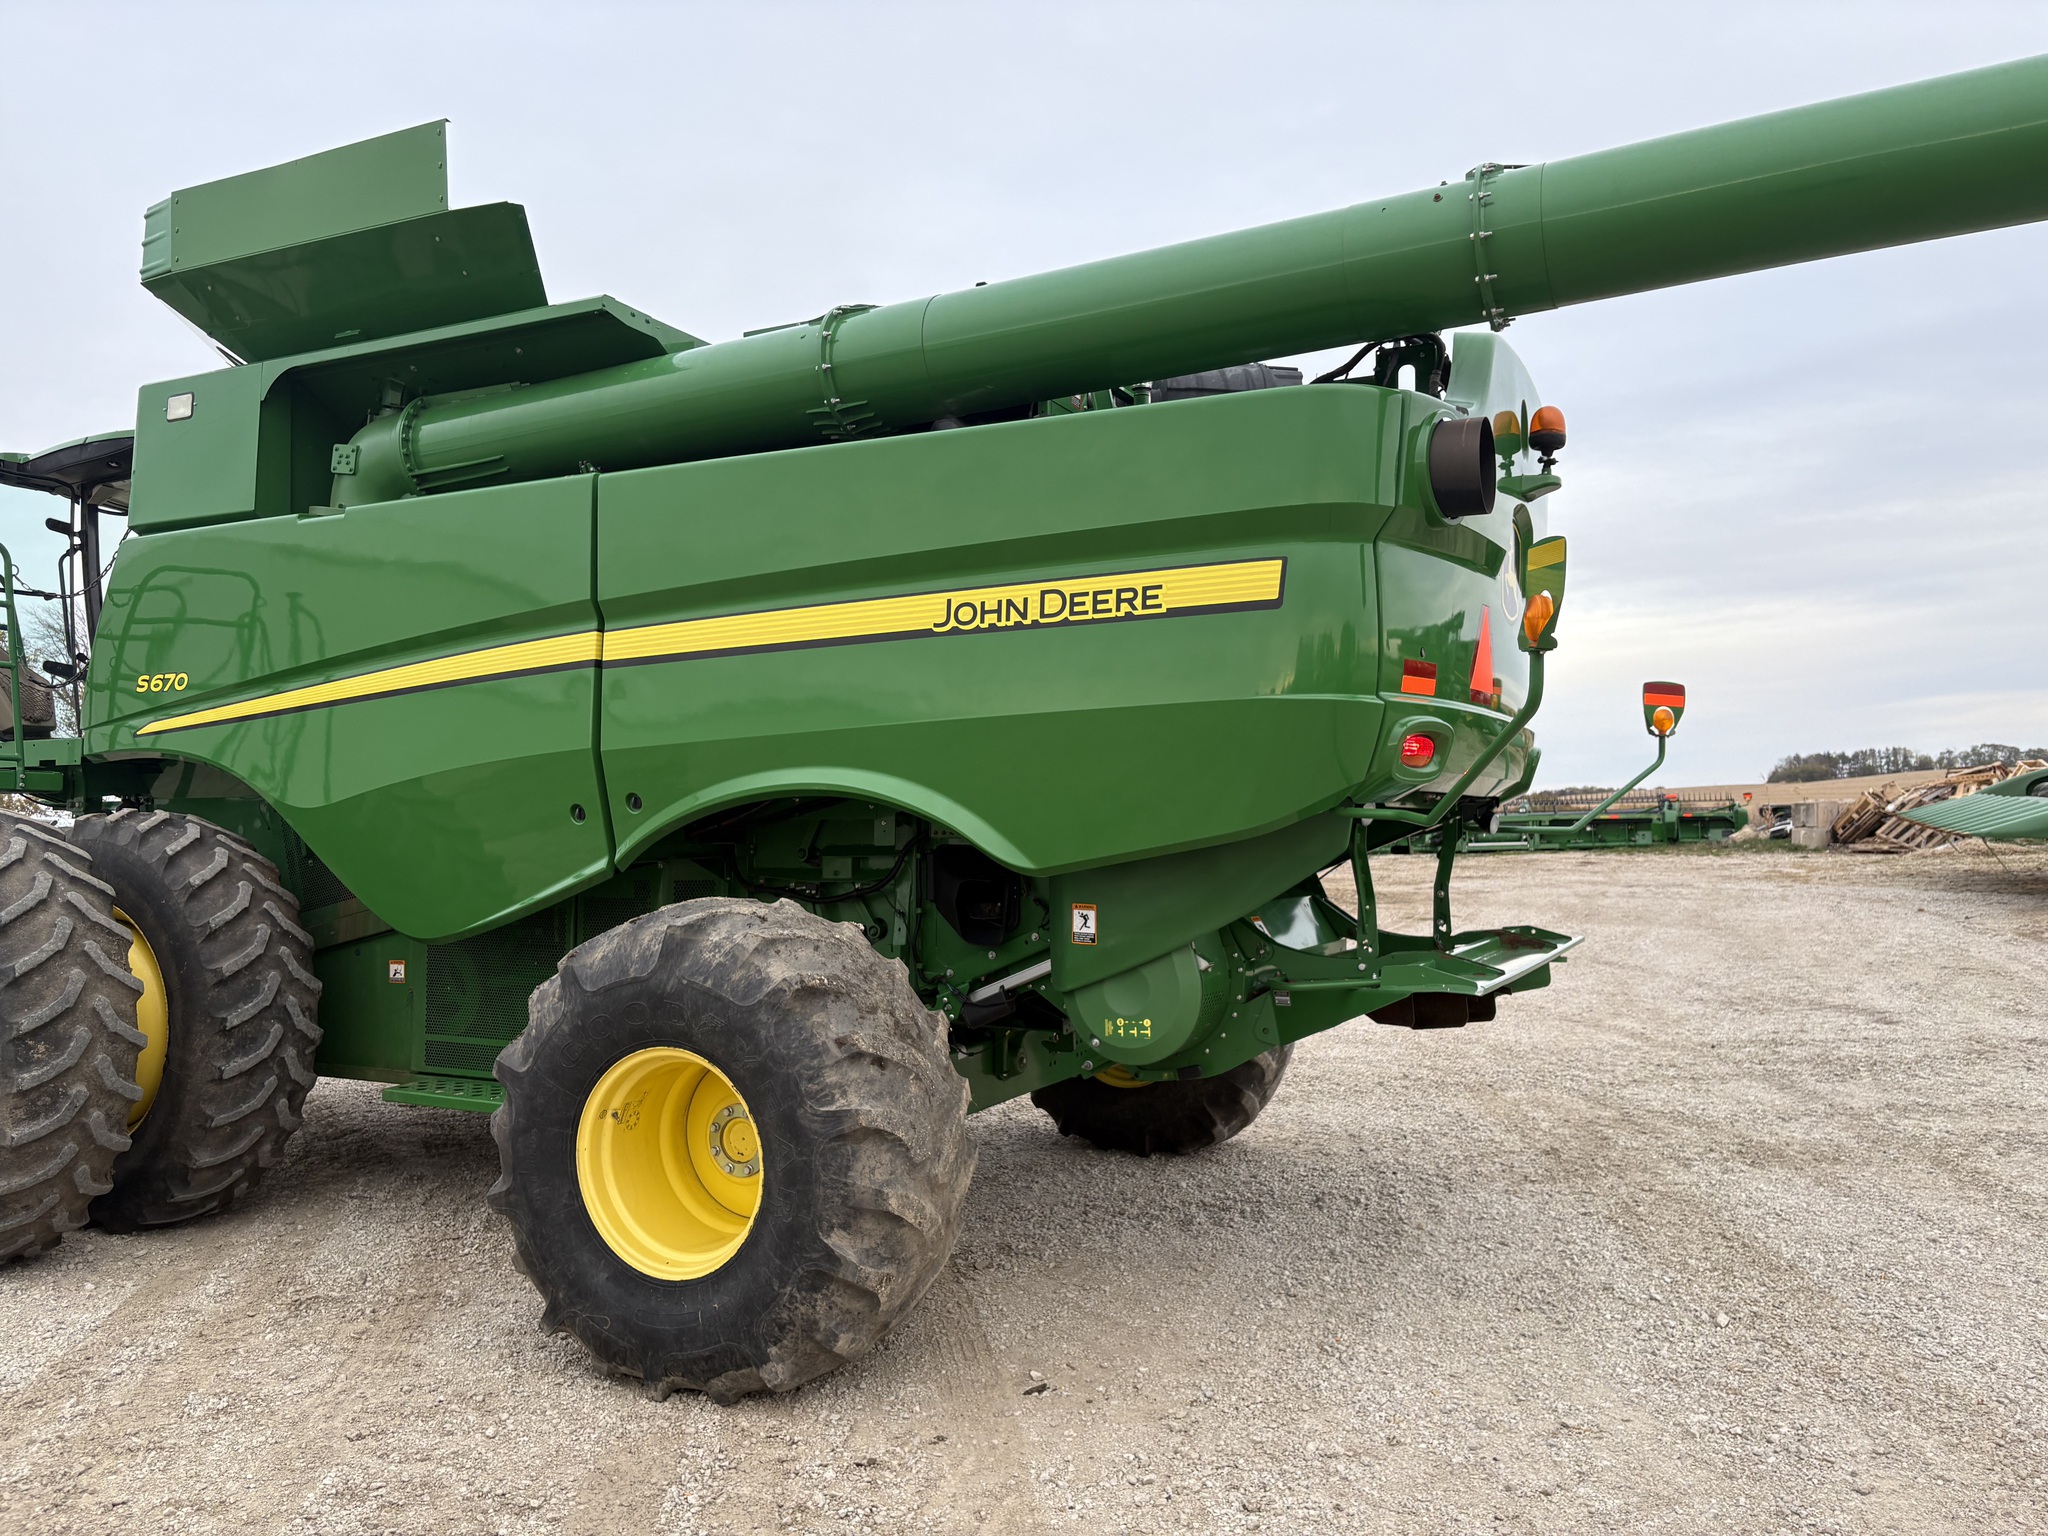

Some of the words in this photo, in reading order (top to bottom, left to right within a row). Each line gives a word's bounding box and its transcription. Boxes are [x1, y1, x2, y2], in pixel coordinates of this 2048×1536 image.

[933, 597, 1029, 628] JOHN
[1039, 584, 1163, 619] DEERE
[136, 672, 188, 693] S670
